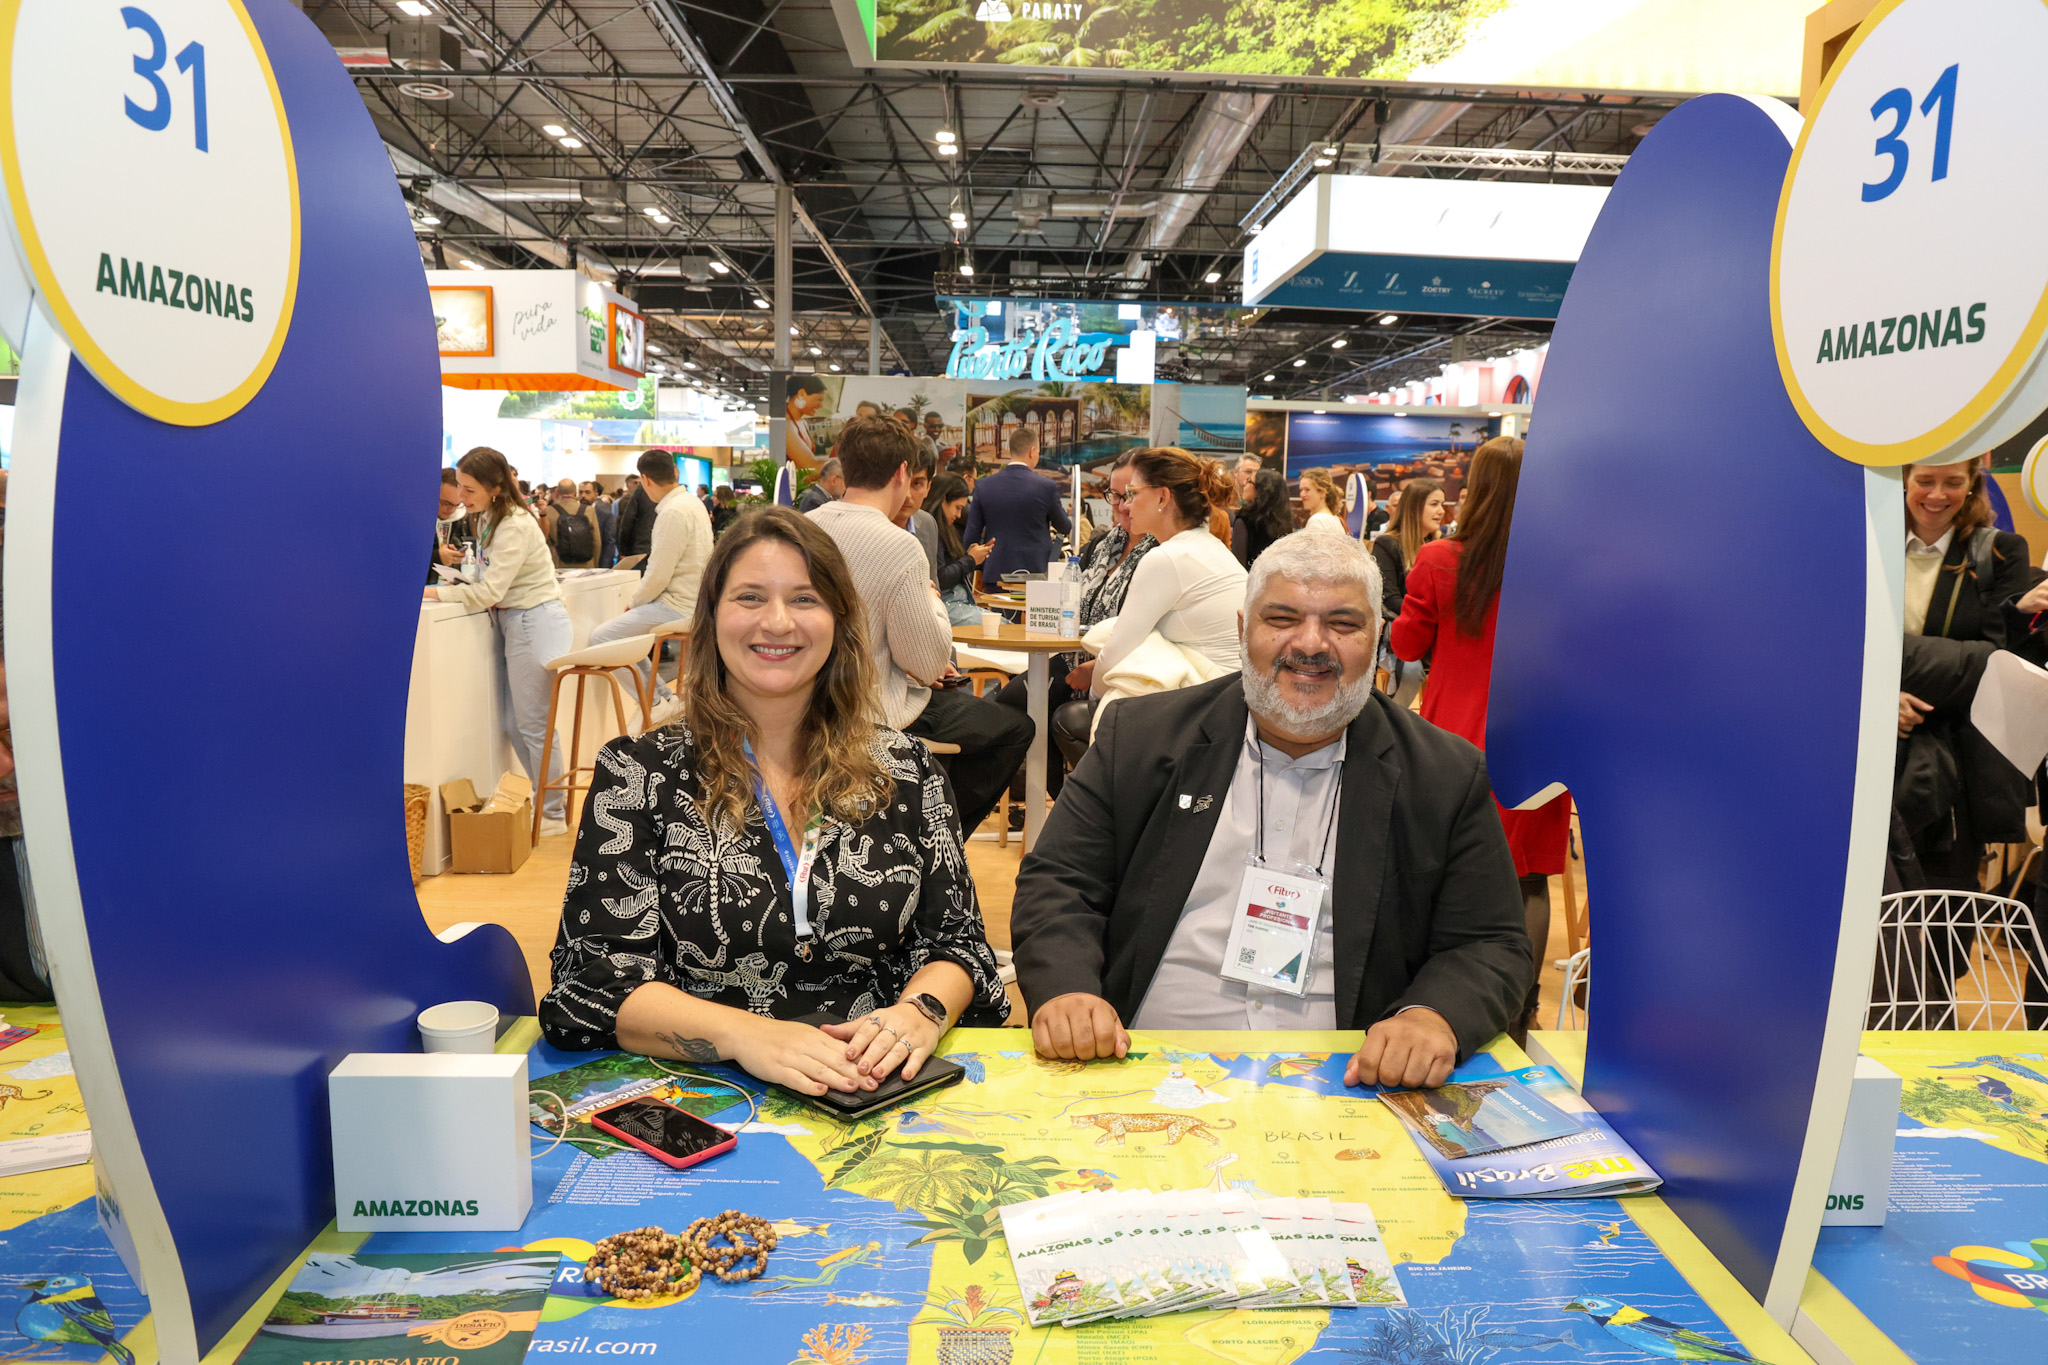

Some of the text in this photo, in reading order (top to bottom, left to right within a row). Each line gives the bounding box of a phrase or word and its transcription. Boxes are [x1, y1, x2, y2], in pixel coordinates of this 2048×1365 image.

[1022, 2, 1082, 21] PARATY
[121, 6, 209, 153] 31
[1861, 63, 1958, 203] 31
[96, 252, 254, 323] AMAZONAS
[513, 301, 552, 335] pura
[521, 317, 557, 341] vida
[1816, 302, 1987, 364] AMAZONAS
[945, 317, 1113, 382] Puerto Rico
[1038, 621, 1057, 629] BRASIL
[1273, 885, 1296, 898] Fitur
[1264, 909, 1294, 919] VISITANTE
[562, 1075, 678, 1118] MEETING BRASIL
[1264, 1130, 1356, 1142] BRASIL
[1454, 1162, 1560, 1189] Brasil
[353, 1200, 479, 1217] AMAZONAS
[1017, 1237, 1093, 1259] AMAZONAS
[528, 1336, 657, 1355] rasil.com
